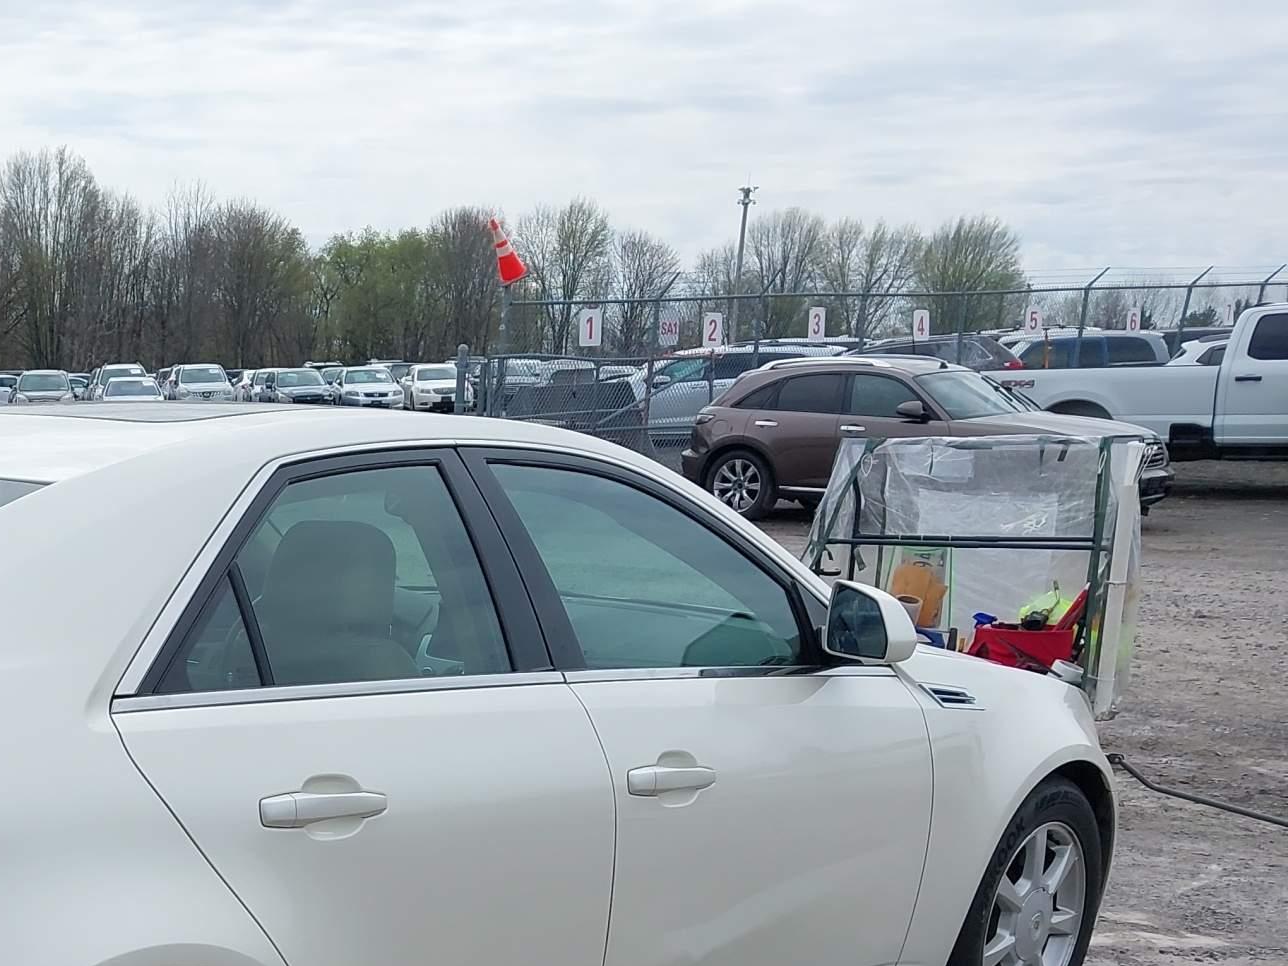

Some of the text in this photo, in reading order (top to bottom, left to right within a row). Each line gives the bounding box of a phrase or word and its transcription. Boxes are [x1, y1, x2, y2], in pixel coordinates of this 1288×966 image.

[585, 317, 594, 340] 1
[661, 321, 678, 336] SA1
[707, 319, 718, 342] 2
[812, 313, 821, 335] 3
[917, 316, 925, 336] 4
[1029, 311, 1038, 330] 5
[1129, 315, 1137, 331] 6
